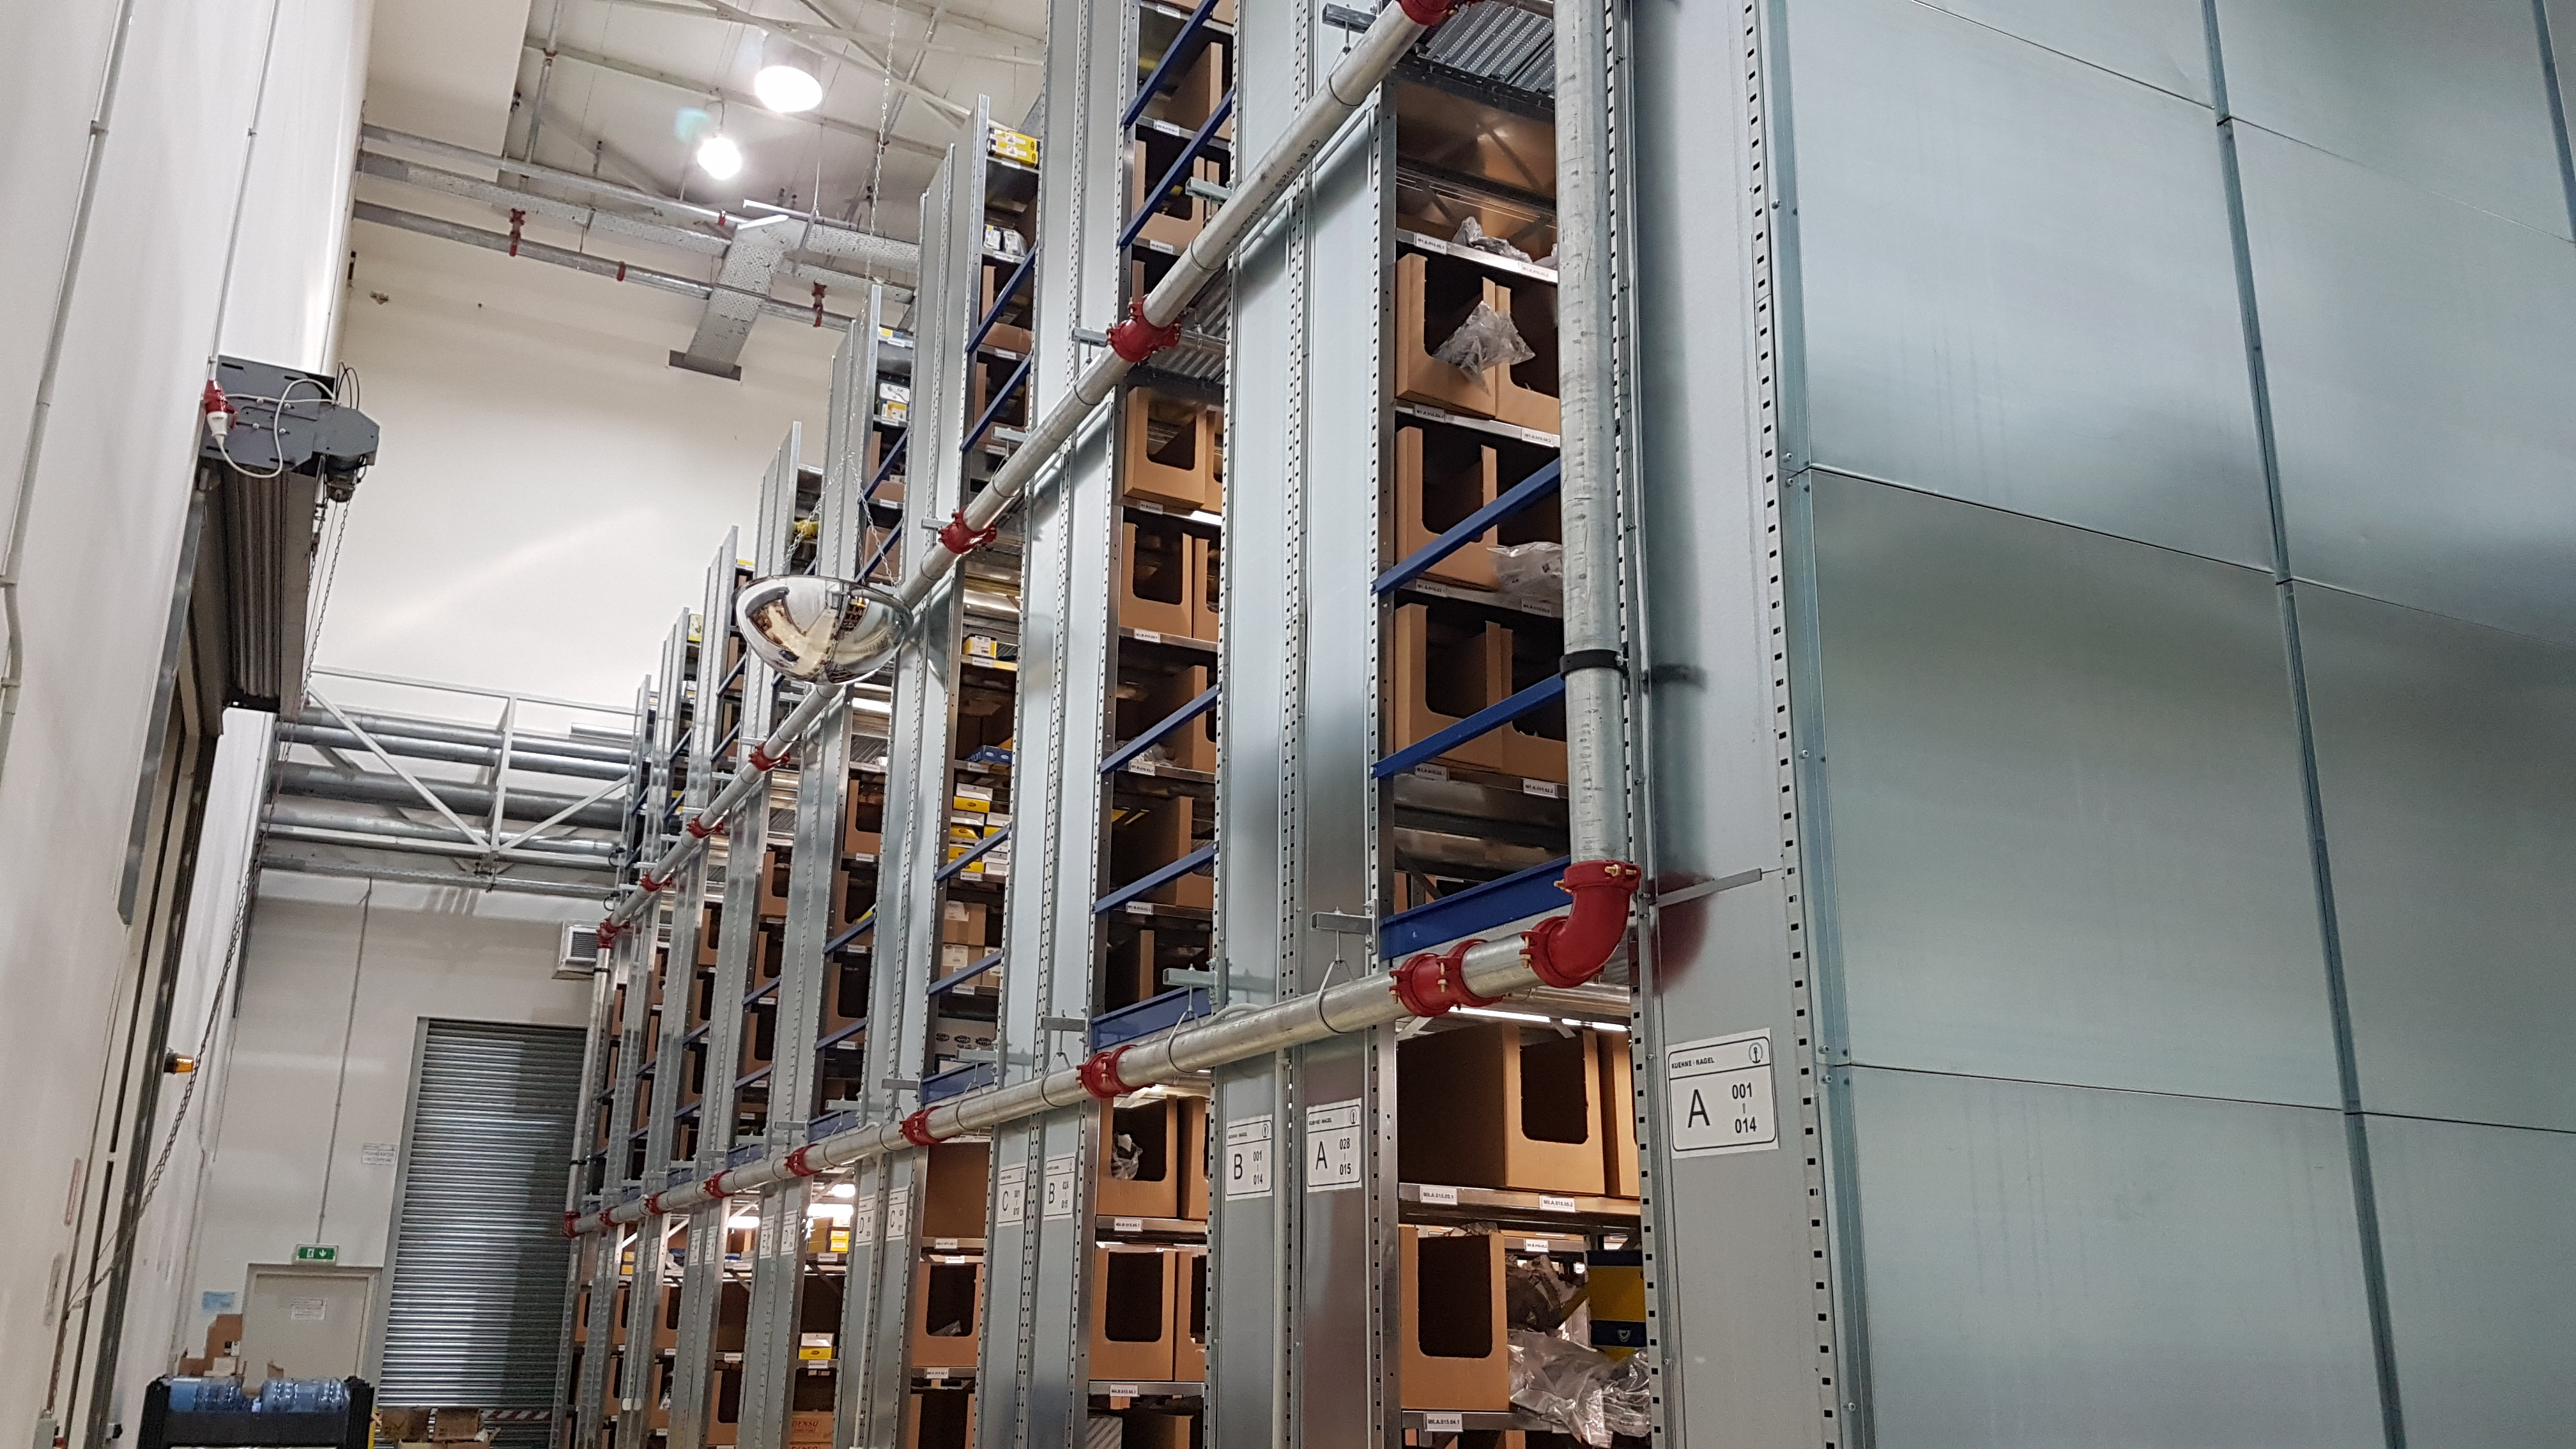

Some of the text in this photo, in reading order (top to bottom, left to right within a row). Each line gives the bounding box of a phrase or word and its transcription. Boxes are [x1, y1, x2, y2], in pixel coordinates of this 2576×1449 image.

[1732, 1082, 1752, 1100] 001
[1687, 1089, 1710, 1128] A
[1735, 1116, 1757, 1133] 014
[1339, 1137, 1350, 1150] 028
[1253, 1150, 1262, 1162] 001
[1315, 1140, 1328, 1170] A
[1234, 1153, 1243, 1180] B
[1340, 1163, 1351, 1175] 015
[1254, 1174, 1263, 1185] 014
[1002, 1190, 1009, 1211] C
[1048, 1183, 1055, 1204] B
[859, 1217, 864, 1234] D
[890, 1210, 896, 1228] C
